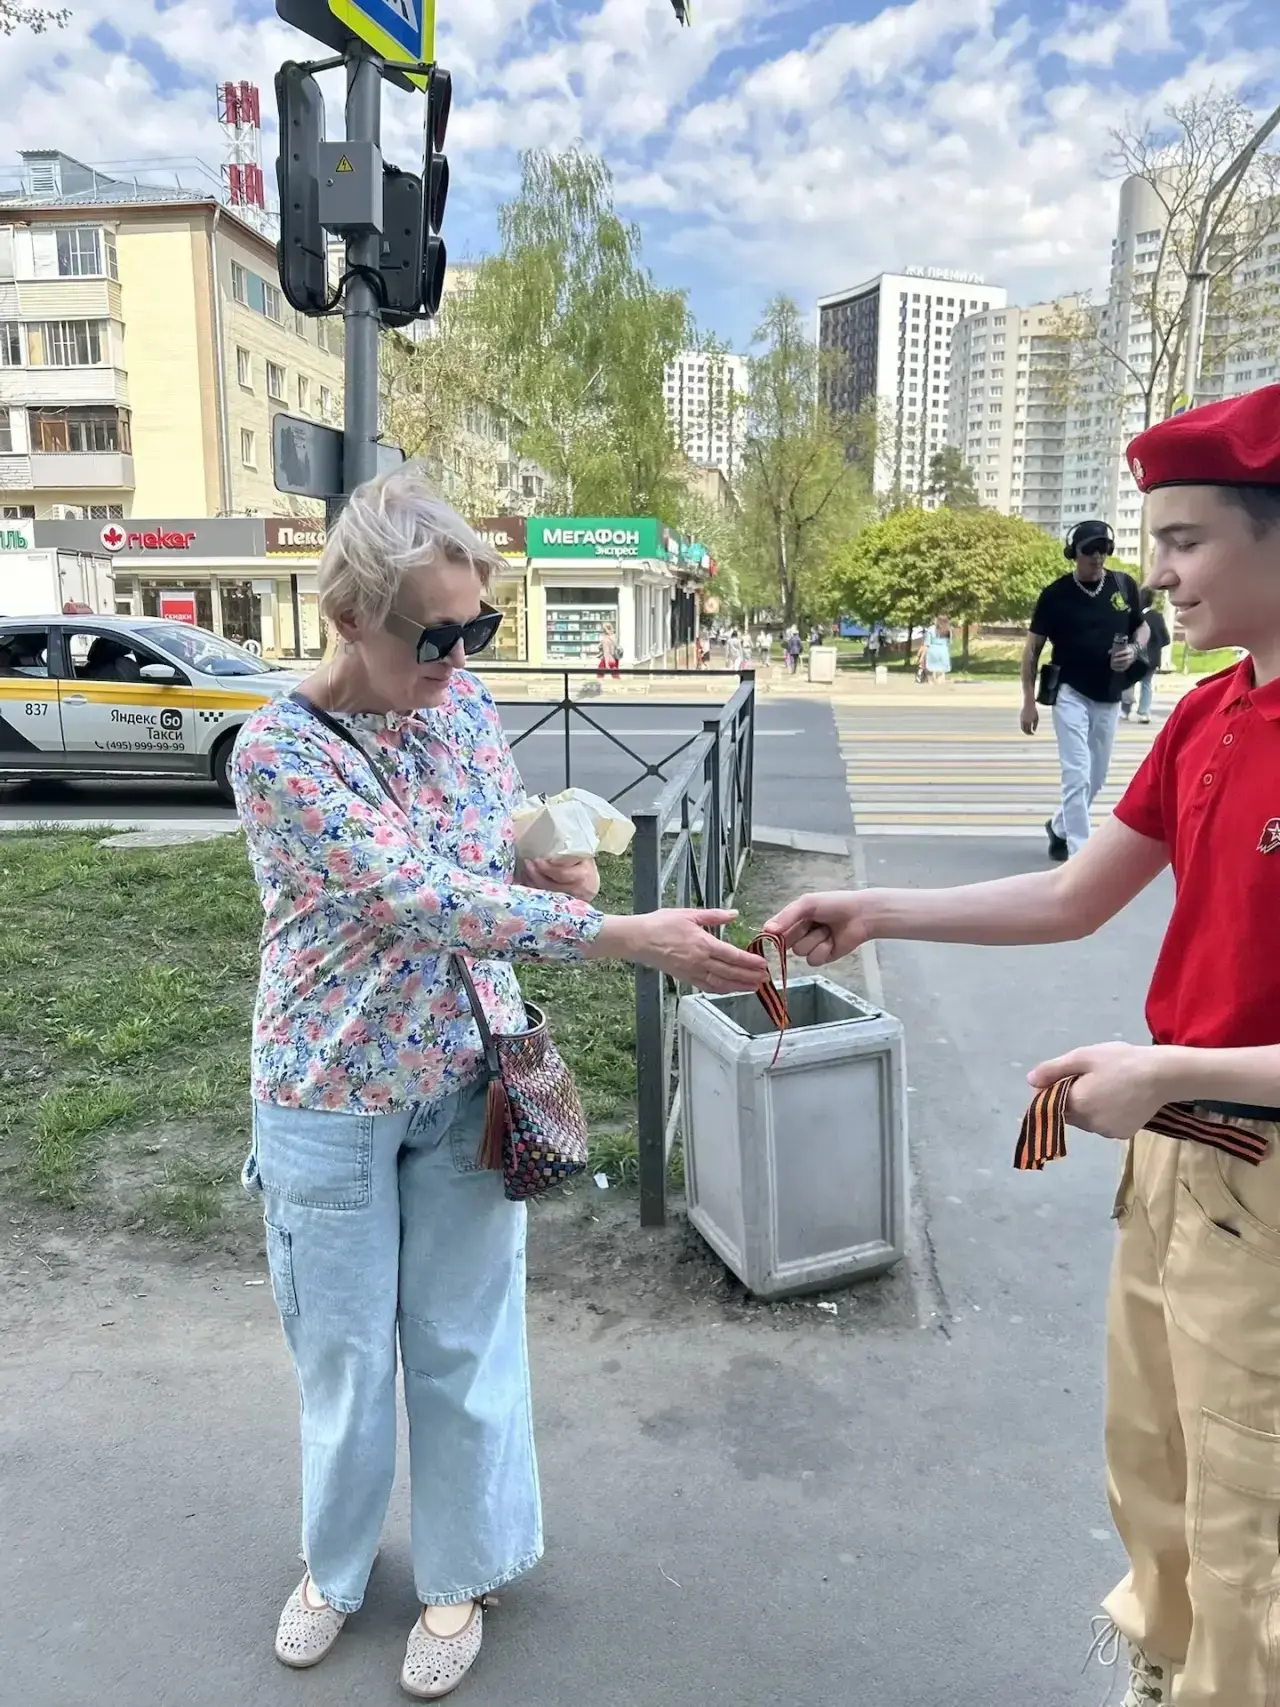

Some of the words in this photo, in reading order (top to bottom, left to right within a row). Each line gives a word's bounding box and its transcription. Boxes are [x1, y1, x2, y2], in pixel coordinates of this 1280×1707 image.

[0, 530, 28, 549] ЛЬ
[128, 526, 197, 549] rieker
[278, 527, 327, 546] Пека
[25, 703, 48, 716] 837
[111, 709, 157, 725] Яндекс
[162, 712, 181, 727] Go
[146, 726, 183, 740] Такси
[106, 740, 132, 750] (495)
[134, 741, 185, 751] 999-99-99
